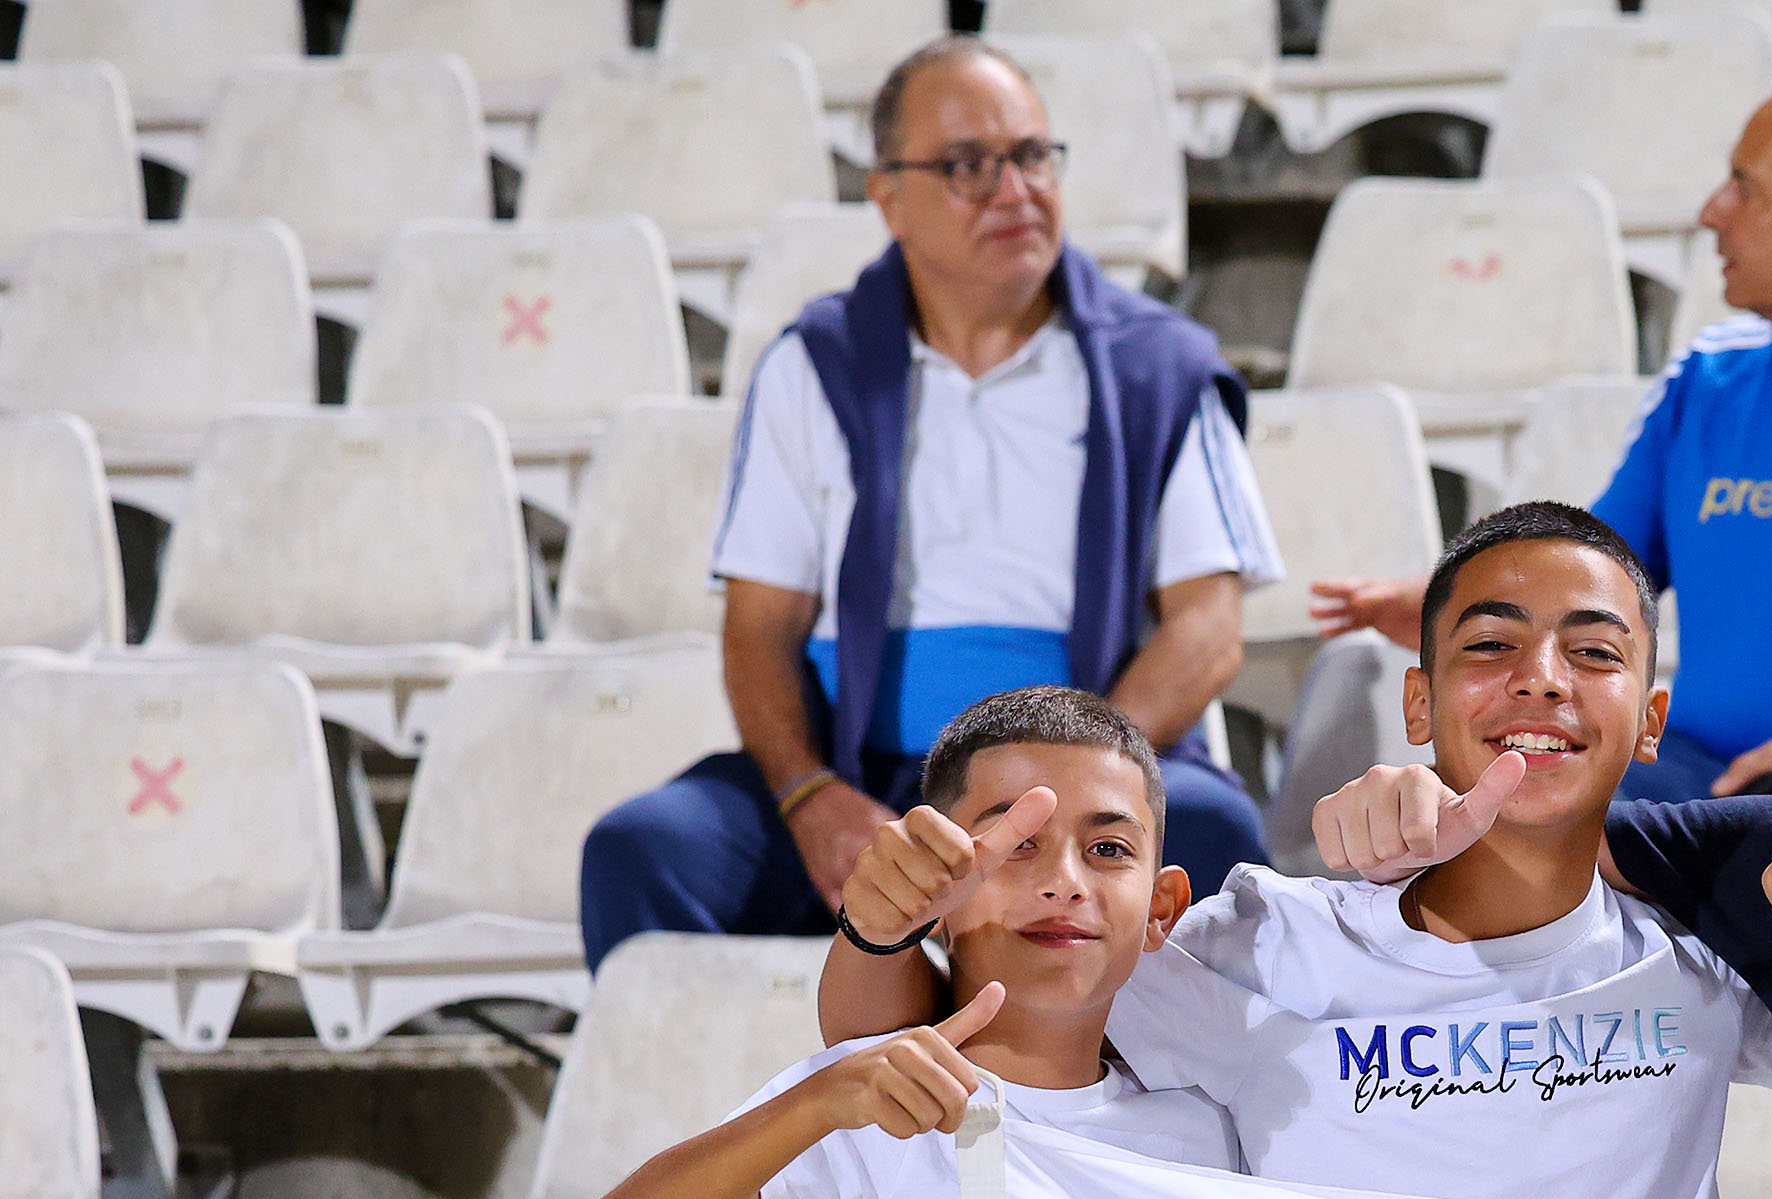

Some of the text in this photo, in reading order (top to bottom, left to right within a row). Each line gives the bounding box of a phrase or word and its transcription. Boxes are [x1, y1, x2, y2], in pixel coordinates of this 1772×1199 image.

[1335, 1006, 1688, 1081] MCKENZIE
[1354, 1047, 1677, 1114] Original Sportswear
